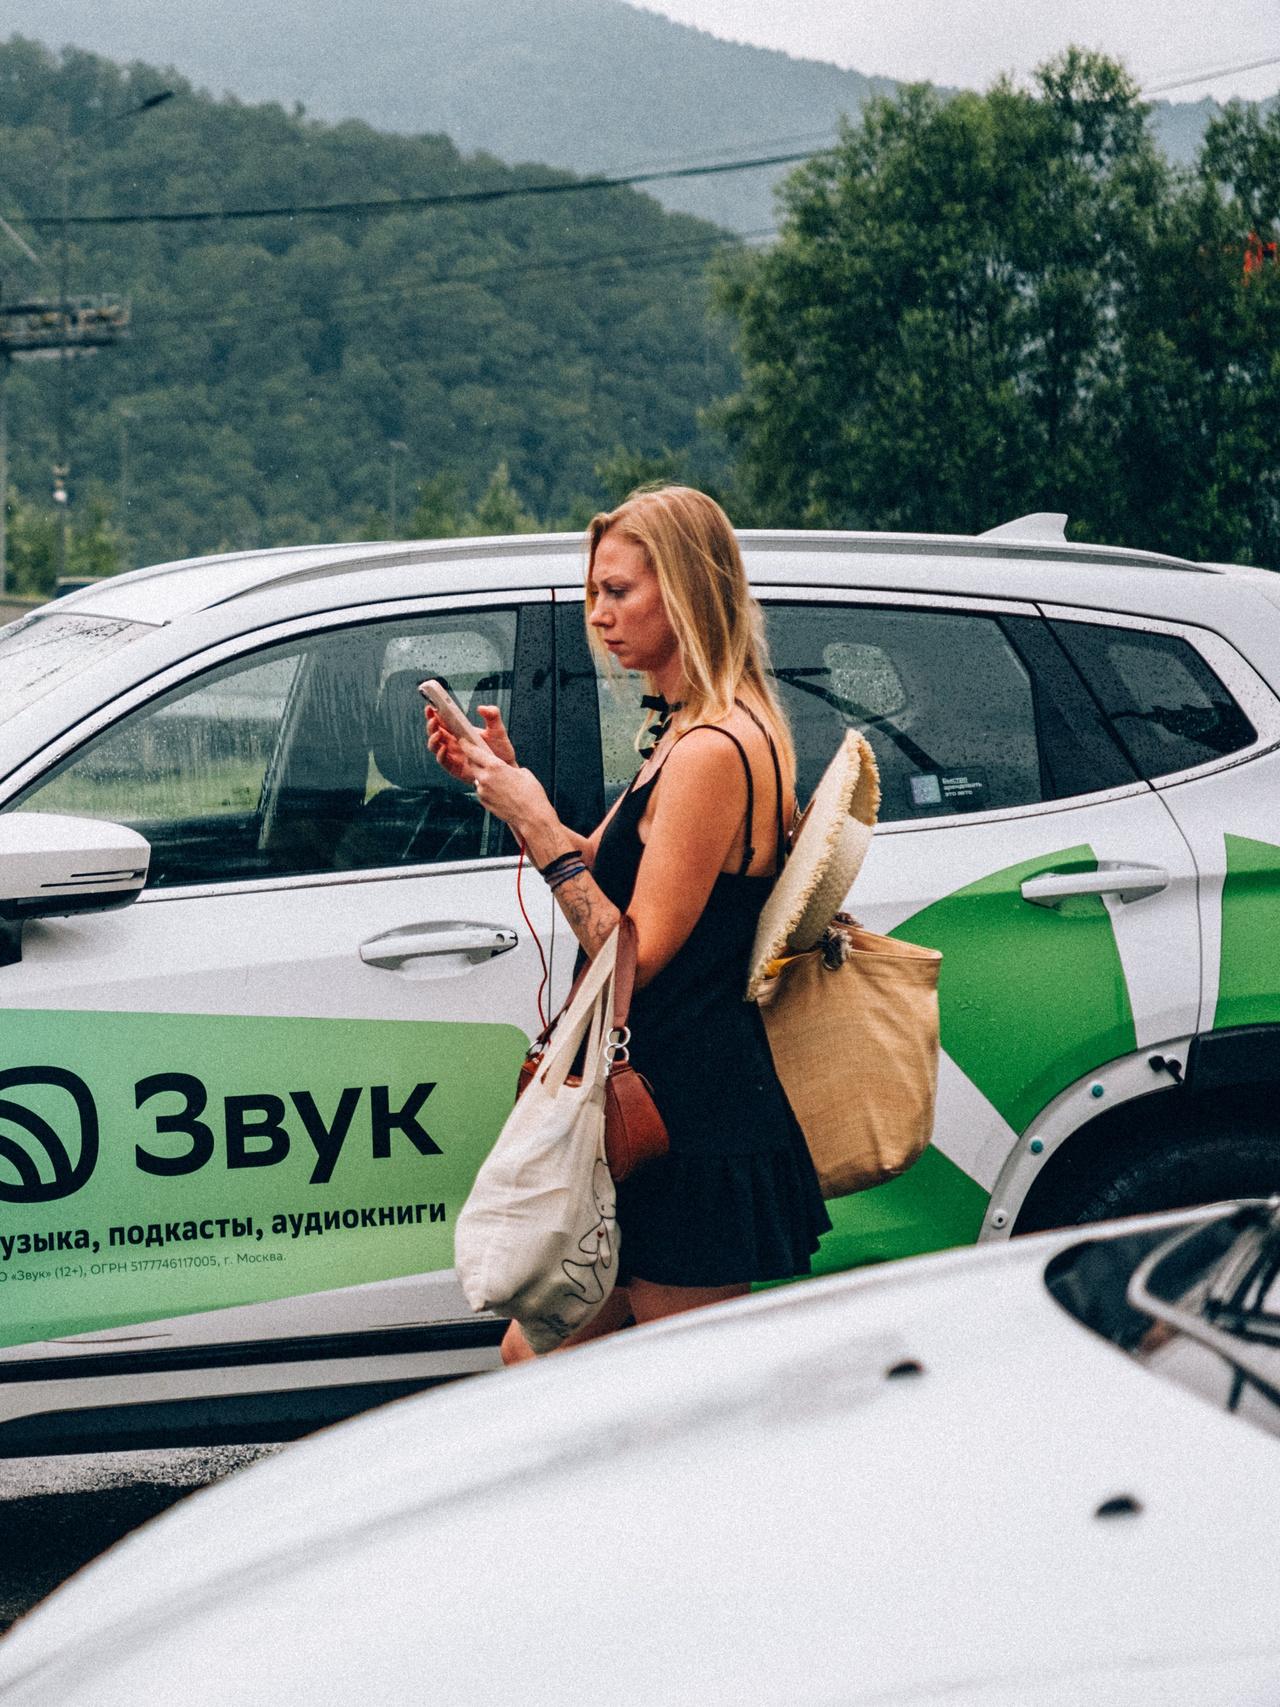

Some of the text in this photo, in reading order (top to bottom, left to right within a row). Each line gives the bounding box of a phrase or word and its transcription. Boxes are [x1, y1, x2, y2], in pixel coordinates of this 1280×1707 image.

[134, 1072, 444, 1184] Звук
[109, 1216, 264, 1247] подкасты,
[272, 1202, 446, 1239] аудиокниги
[10, 1268, 52, 1282] «Звук»
[55, 1265, 87, 1280] (12+),
[90, 1262, 127, 1276] ОГРН
[130, 1254, 220, 1272] 5177746117005,
[223, 1256, 234, 1265] г.
[237, 1251, 287, 1265] Москва.
